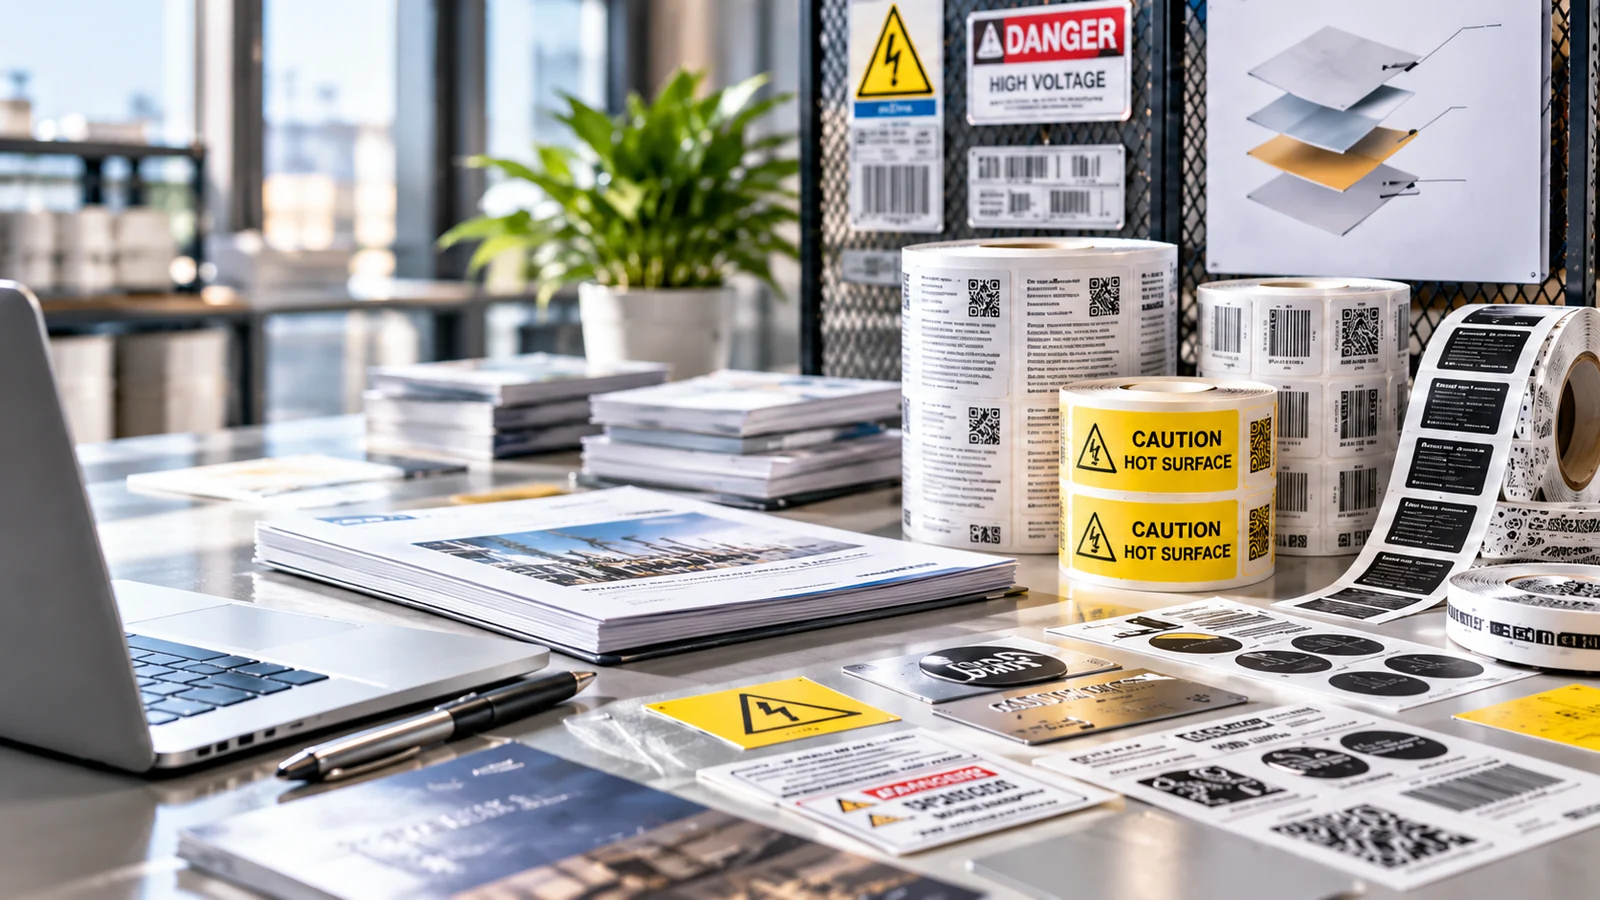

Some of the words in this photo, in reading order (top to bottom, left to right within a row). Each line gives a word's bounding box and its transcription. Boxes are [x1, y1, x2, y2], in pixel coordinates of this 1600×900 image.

[1006, 17, 1117, 55] DANGER
[990, 74, 1027, 93] HIGH
[1032, 71, 1106, 90] VOLTAGE
[1132, 430, 1222, 448] CAUTION
[1124, 455, 1157, 470] HOT
[1162, 454, 1232, 471] SURFACE
[1132, 520, 1221, 539] CAUTION
[1124, 545, 1156, 560] HOT
[1161, 543, 1231, 561] SURFACE
